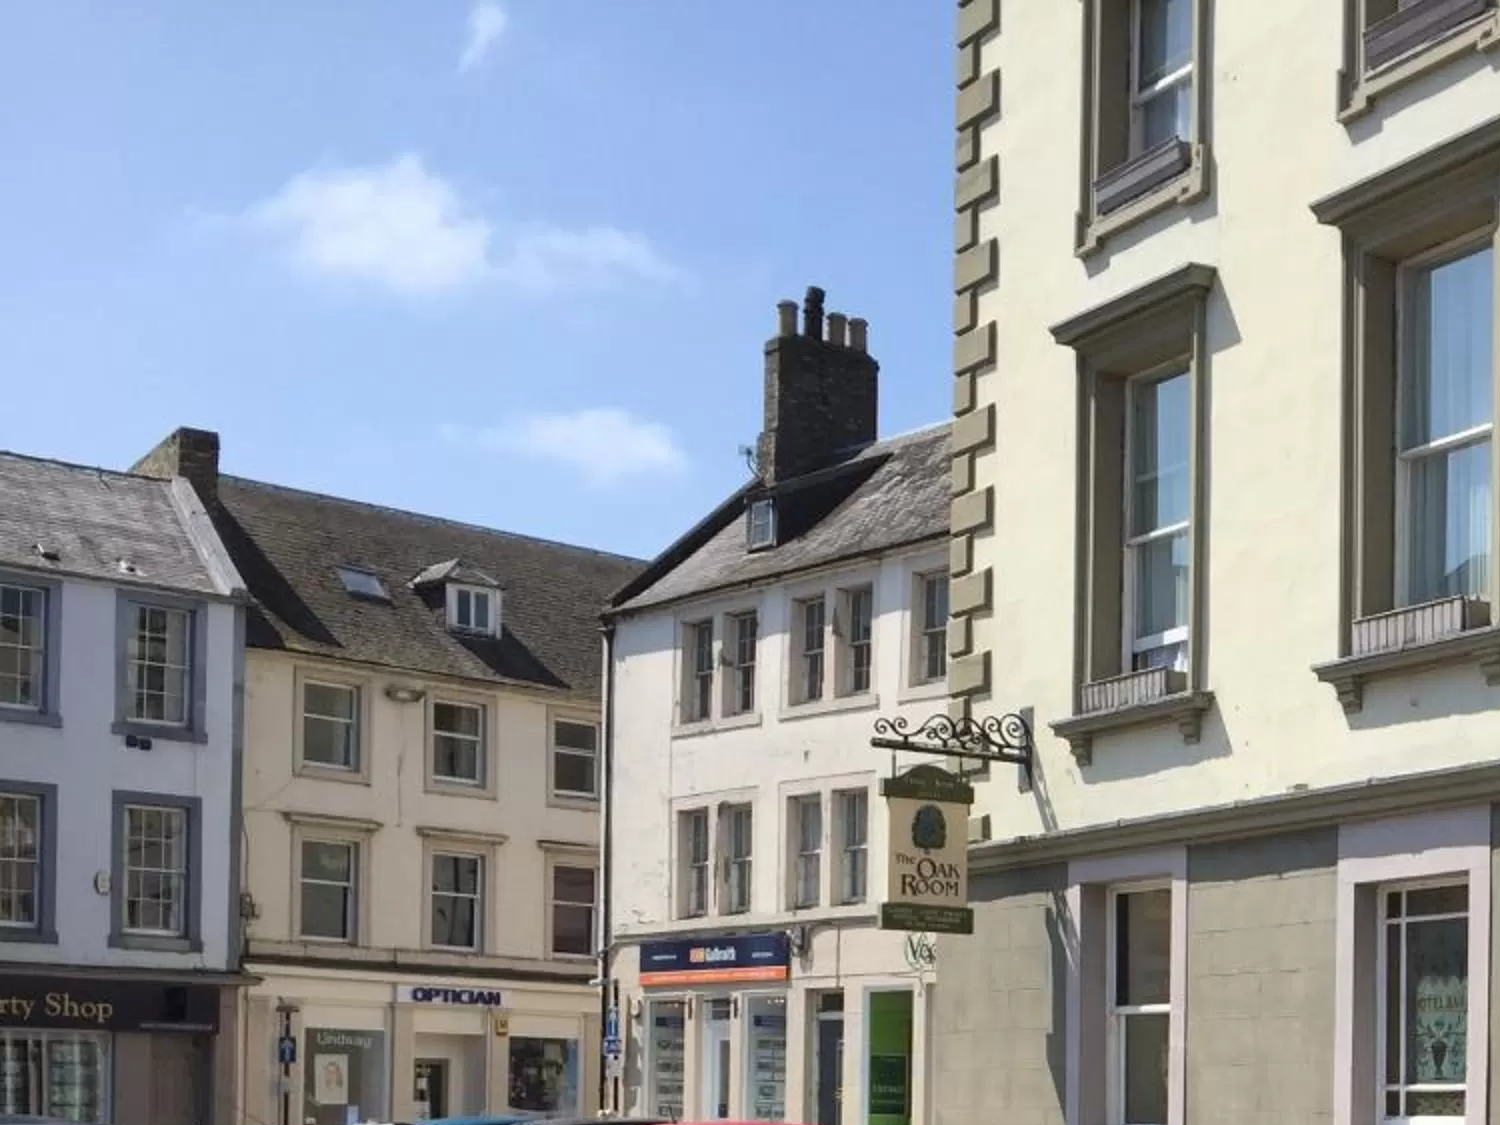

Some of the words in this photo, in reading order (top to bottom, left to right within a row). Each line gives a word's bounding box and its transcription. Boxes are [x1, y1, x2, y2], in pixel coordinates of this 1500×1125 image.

[917, 857, 960, 879] OAK
[901, 874, 959, 896] ROOM
[412, 987, 501, 1005] OPTICIAN
[44, 992, 113, 1023] Shop
